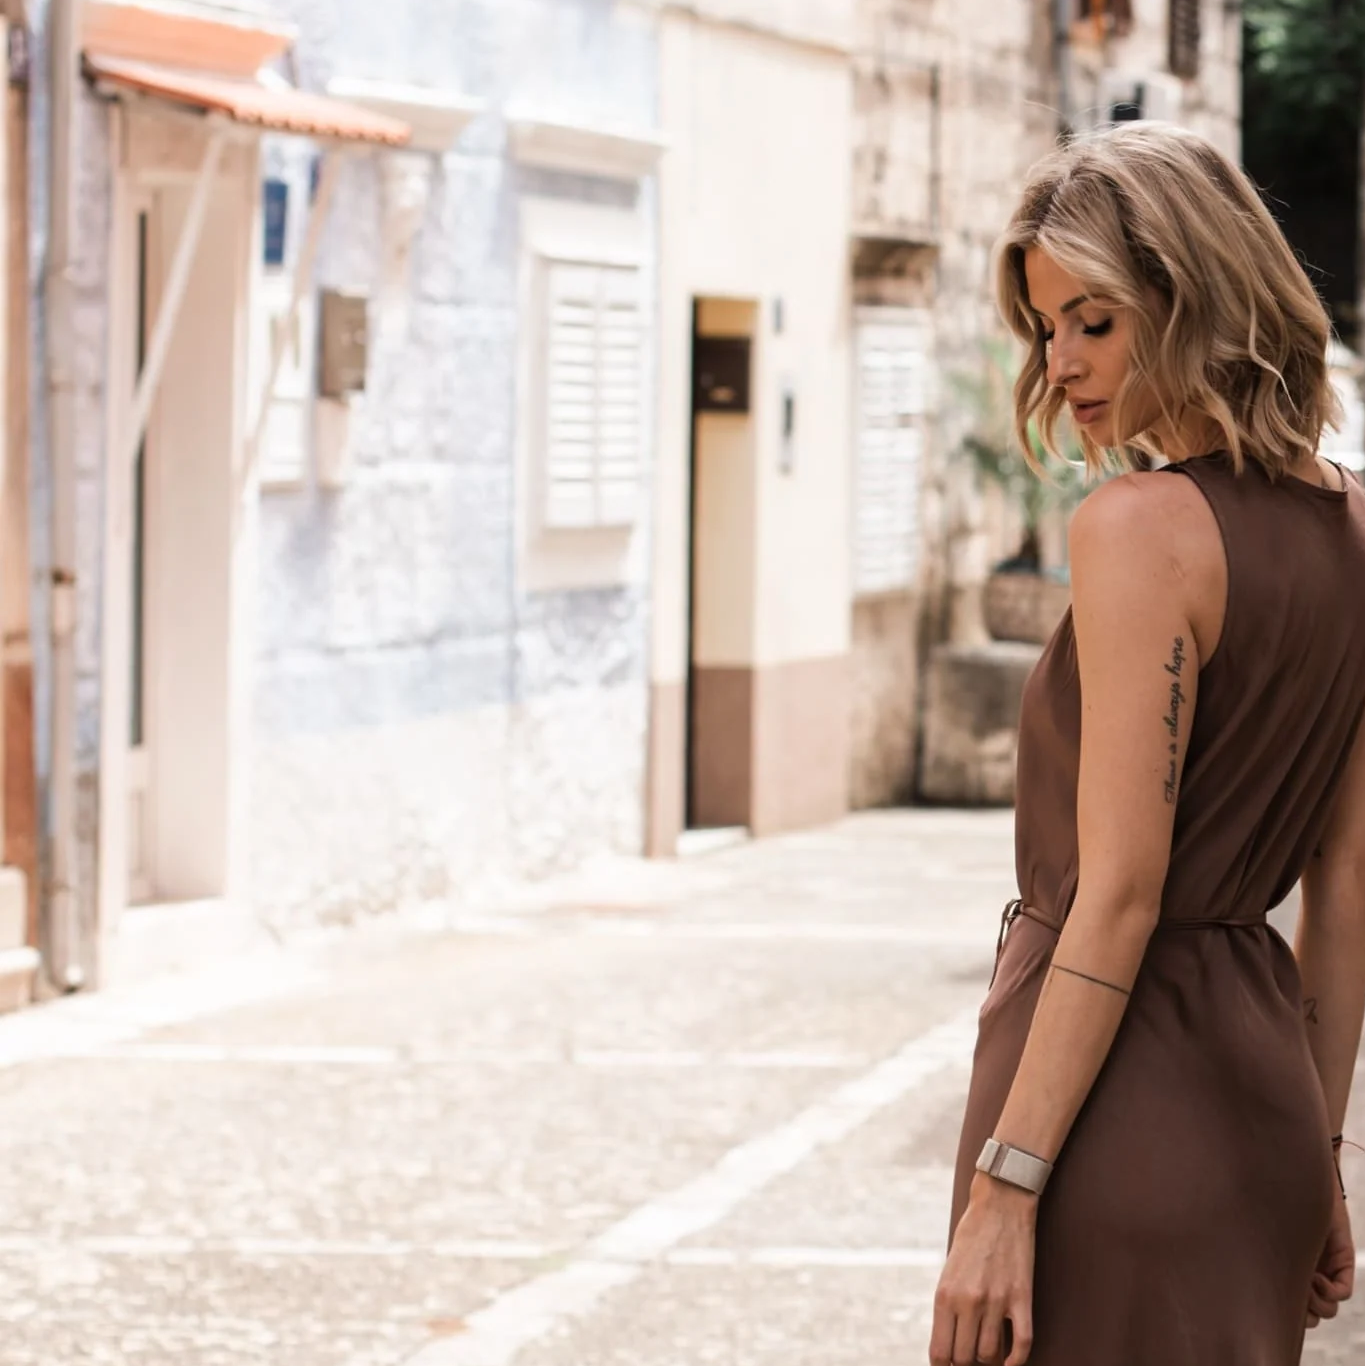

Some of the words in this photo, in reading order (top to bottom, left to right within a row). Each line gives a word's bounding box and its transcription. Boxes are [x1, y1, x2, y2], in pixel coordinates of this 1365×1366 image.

[1164, 636, 1186, 677] hope
[1163, 682, 1186, 737] always
[1164, 760, 1178, 804] There
